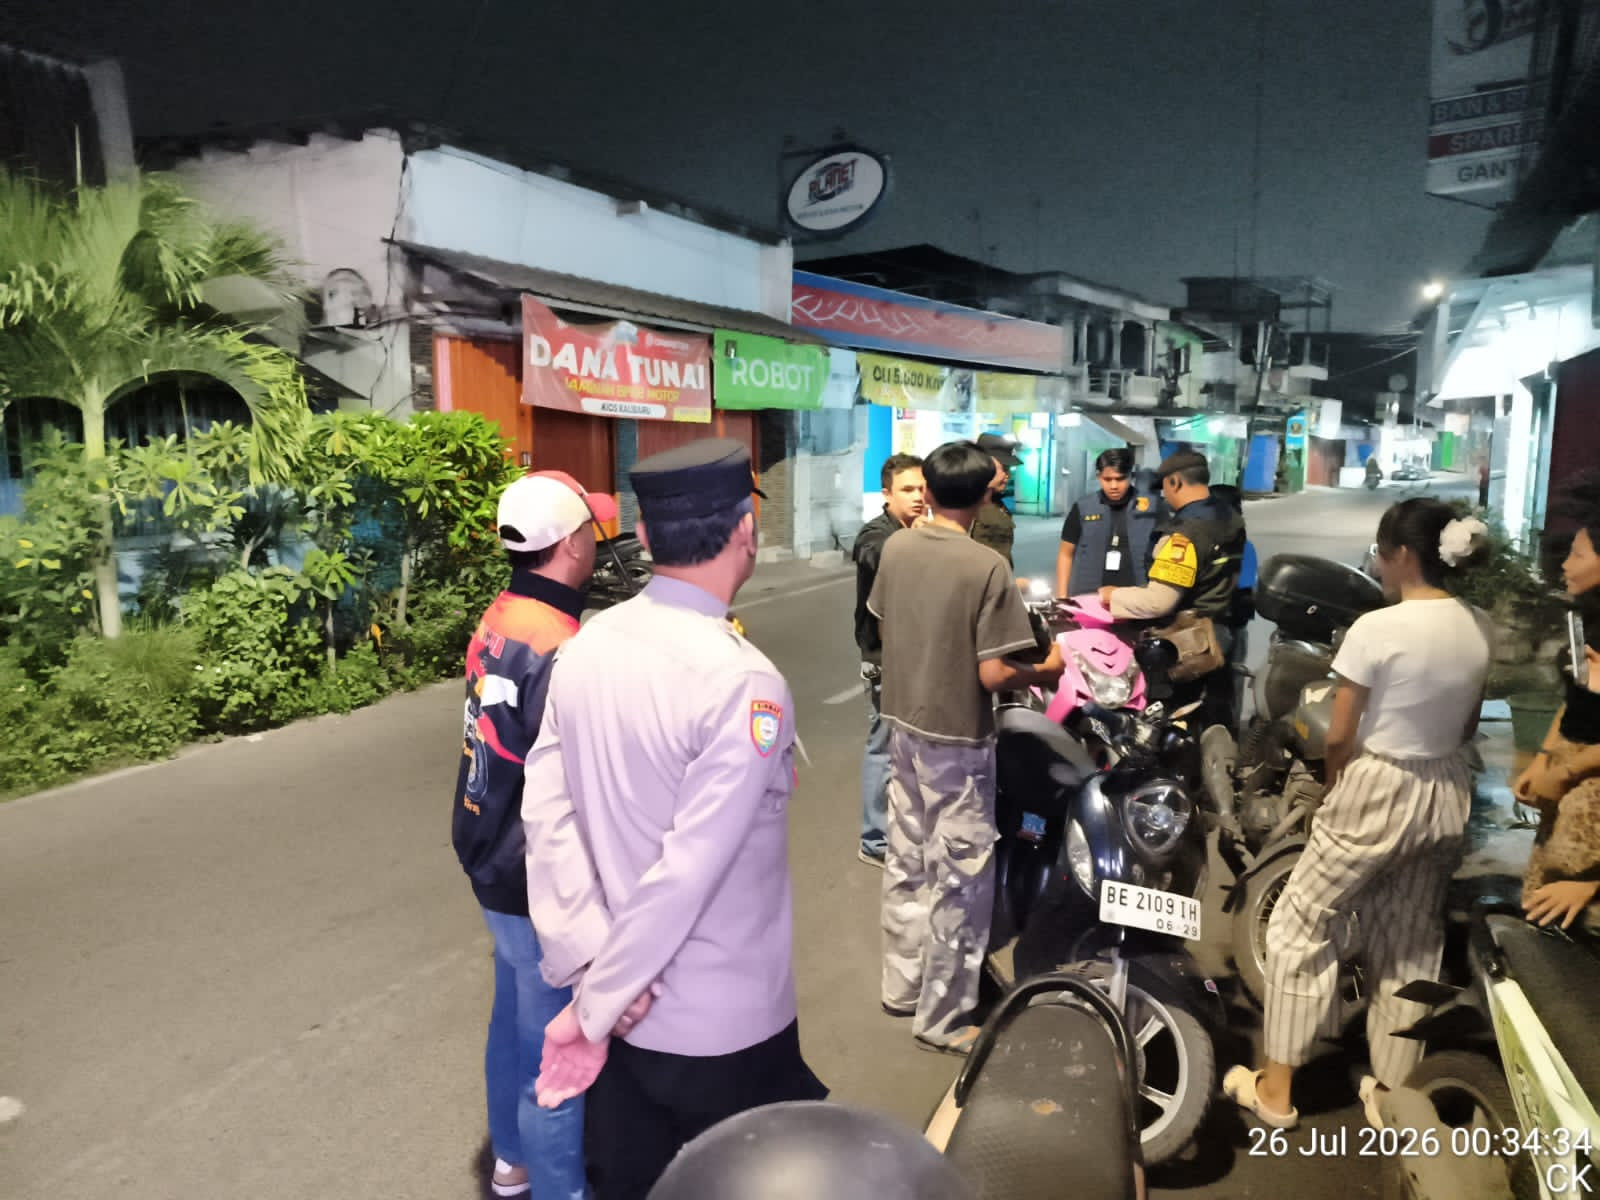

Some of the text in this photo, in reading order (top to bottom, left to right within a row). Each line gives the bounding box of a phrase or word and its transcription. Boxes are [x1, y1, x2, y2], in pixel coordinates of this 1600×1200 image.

[1434, 96, 1482, 121] BAN
[530, 333, 705, 389] DANA TUNAI
[732, 358, 814, 391] ROBOT
[873, 366, 890, 383] OLI
[1107, 886, 1197, 921] BE 2109 IH
